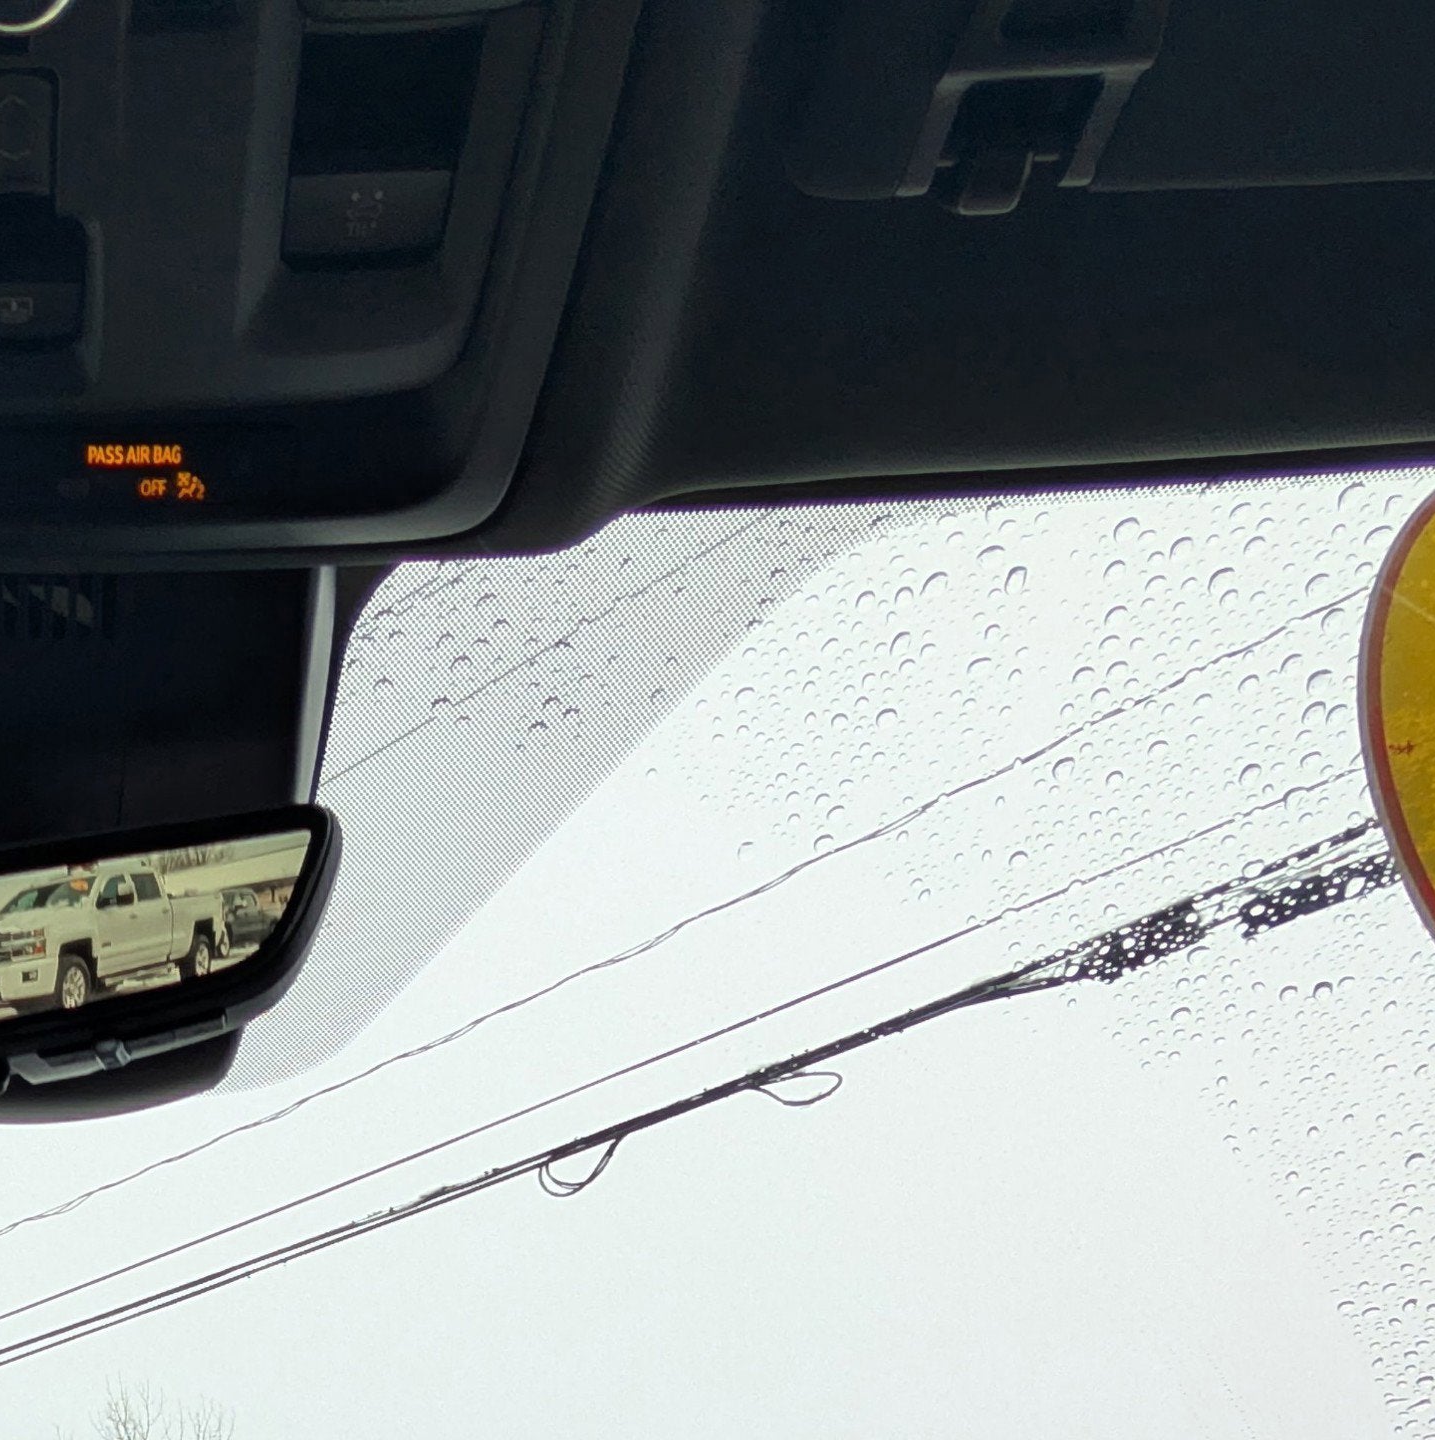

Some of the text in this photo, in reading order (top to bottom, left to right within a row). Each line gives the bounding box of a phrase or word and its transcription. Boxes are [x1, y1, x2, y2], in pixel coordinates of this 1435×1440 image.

[87, 445, 182, 466] PASS AIR BAG
[139, 479, 168, 497] OFF
